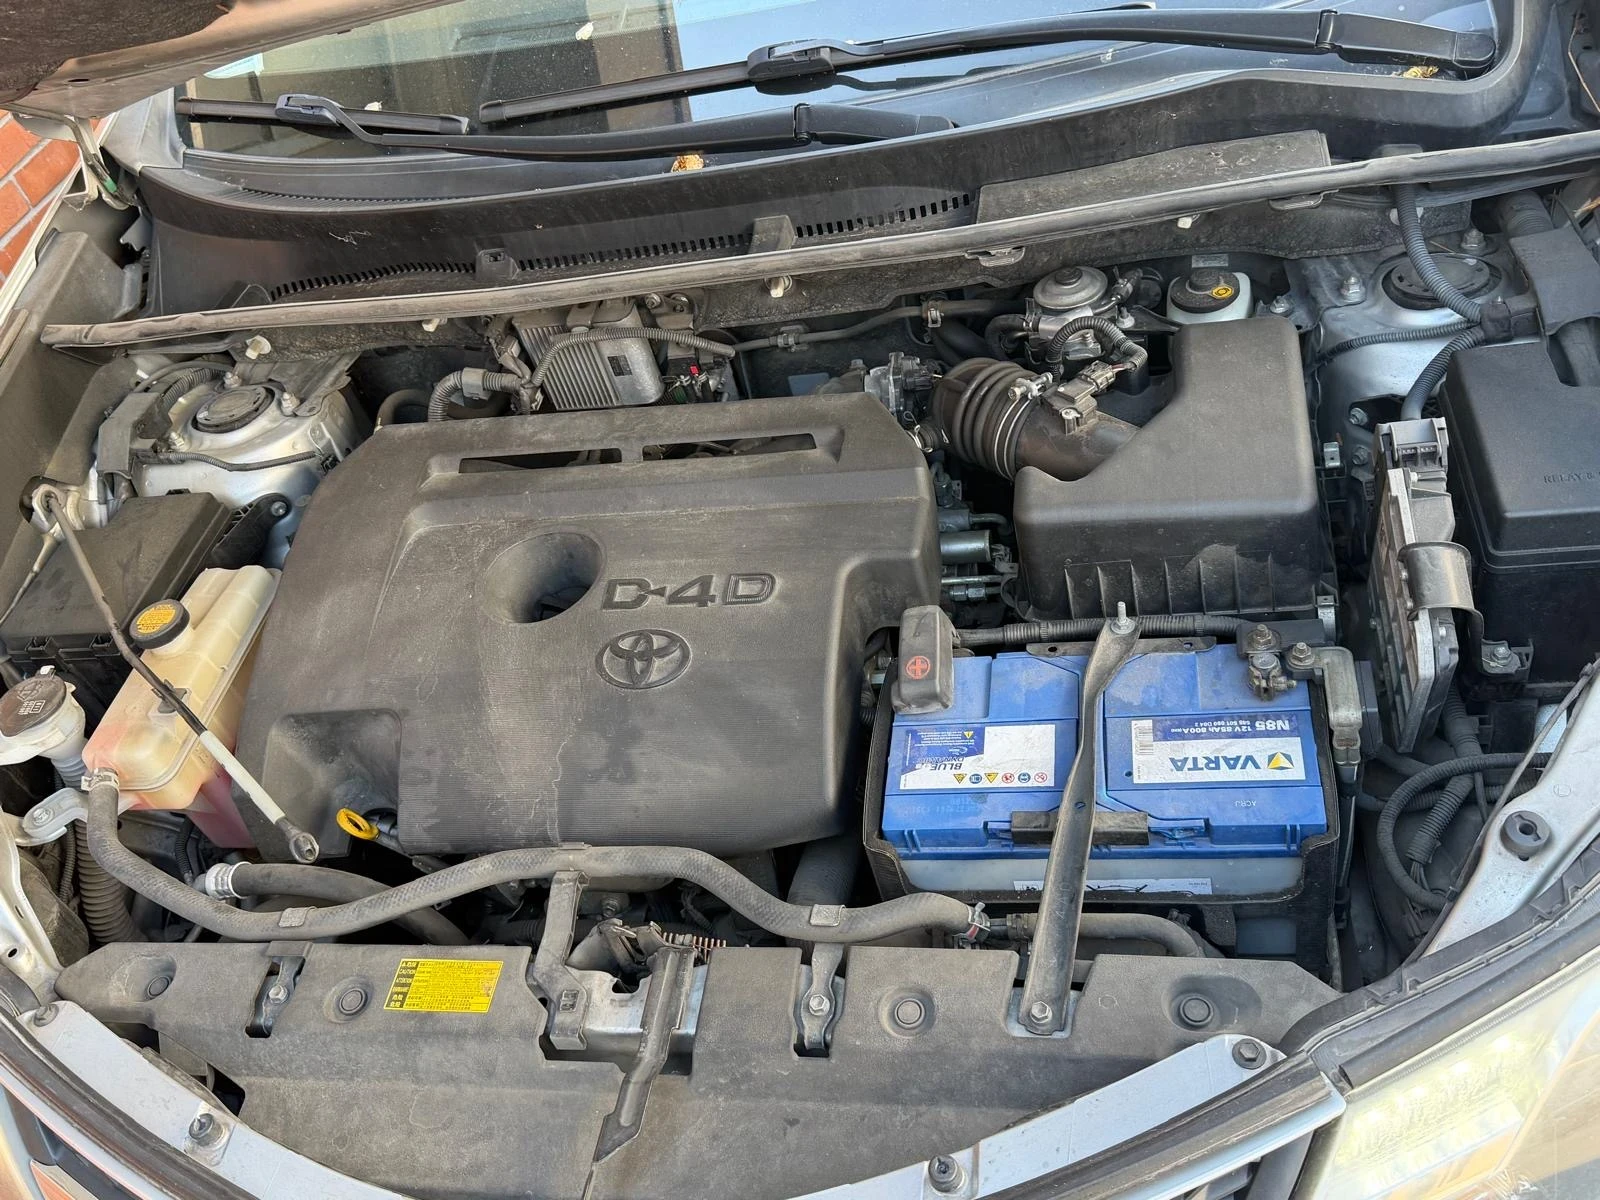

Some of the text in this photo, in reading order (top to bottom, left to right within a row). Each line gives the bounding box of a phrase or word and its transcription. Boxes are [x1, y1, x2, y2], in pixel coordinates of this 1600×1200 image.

[1208, 725, 1233, 733] 85Ah
[1255, 719, 1290, 731] N85
[930, 763, 963, 771] BLUE
[1169, 755, 1261, 772] VARTA
